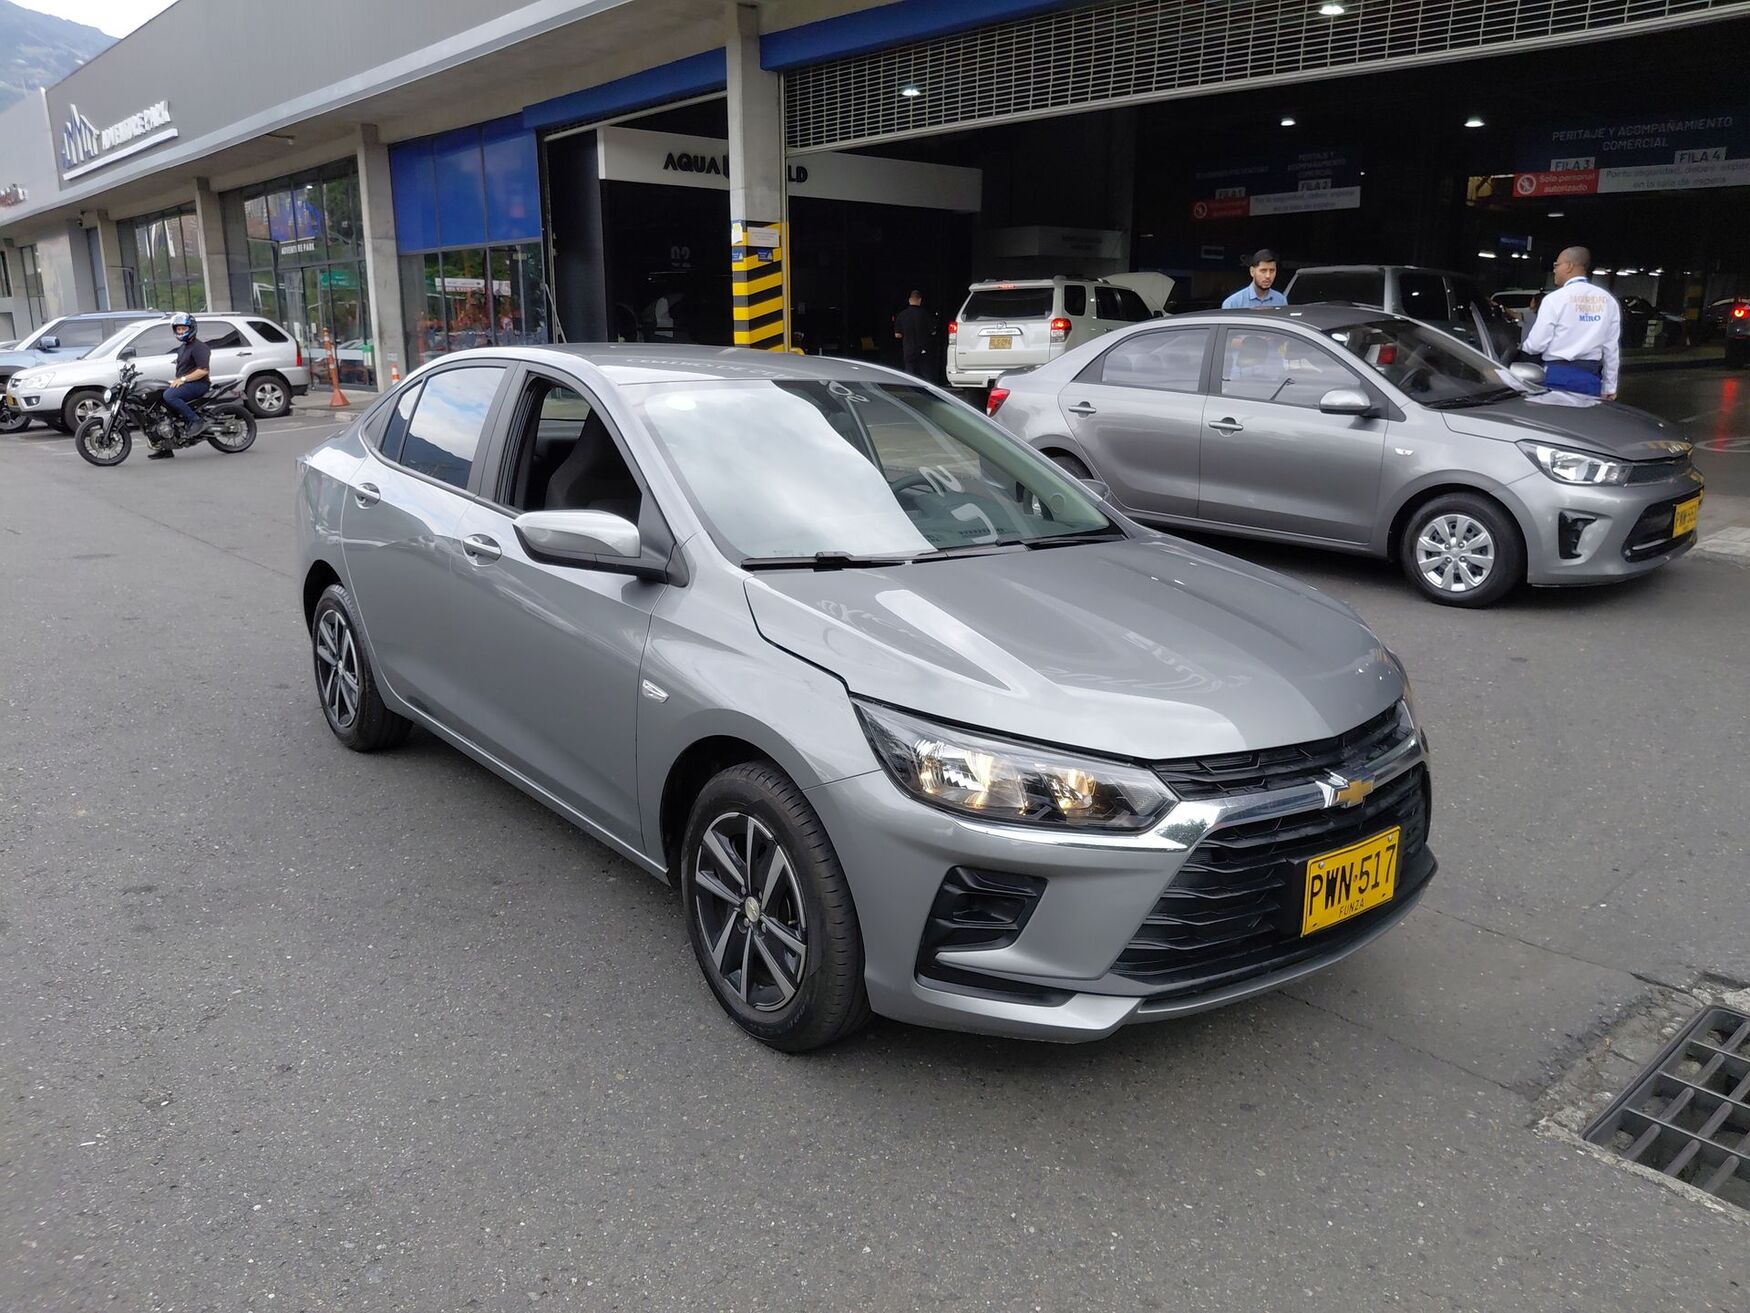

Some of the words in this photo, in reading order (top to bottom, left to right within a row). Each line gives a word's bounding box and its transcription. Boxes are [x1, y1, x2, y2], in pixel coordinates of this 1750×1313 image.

[1552, 127, 1605, 142] PERITAJE
[1618, 116, 1733, 138] ACOMPAÑAMIENTO
[1603, 137, 1669, 151] COMERCIAL
[663, 152, 721, 175] AQUA
[1555, 160, 1580, 171] FILA
[1679, 151, 1708, 163] FILA
[1339, 898, 1365, 918] FUNZA
